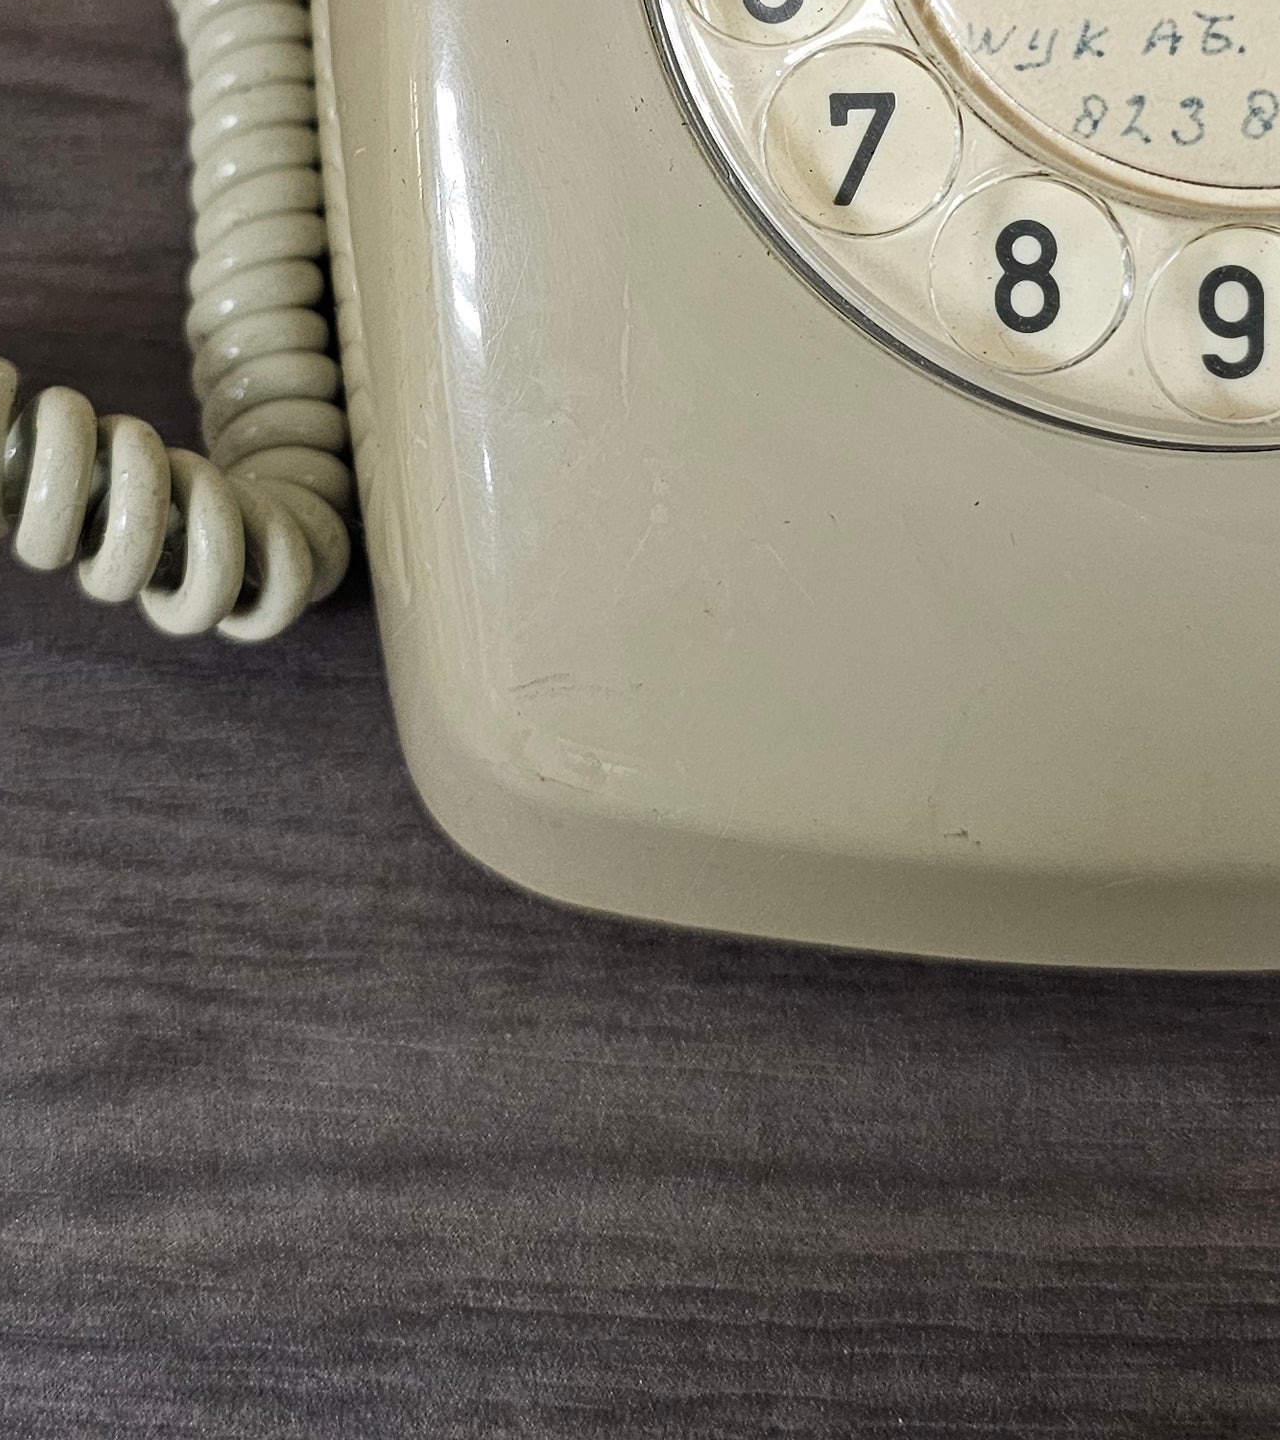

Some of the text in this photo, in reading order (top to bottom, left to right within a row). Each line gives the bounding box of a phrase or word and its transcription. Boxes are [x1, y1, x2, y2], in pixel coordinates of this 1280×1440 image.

[827, 91, 897, 208] 7
[993, 218, 1062, 335] 8
[1197, 263, 1266, 381] 9
